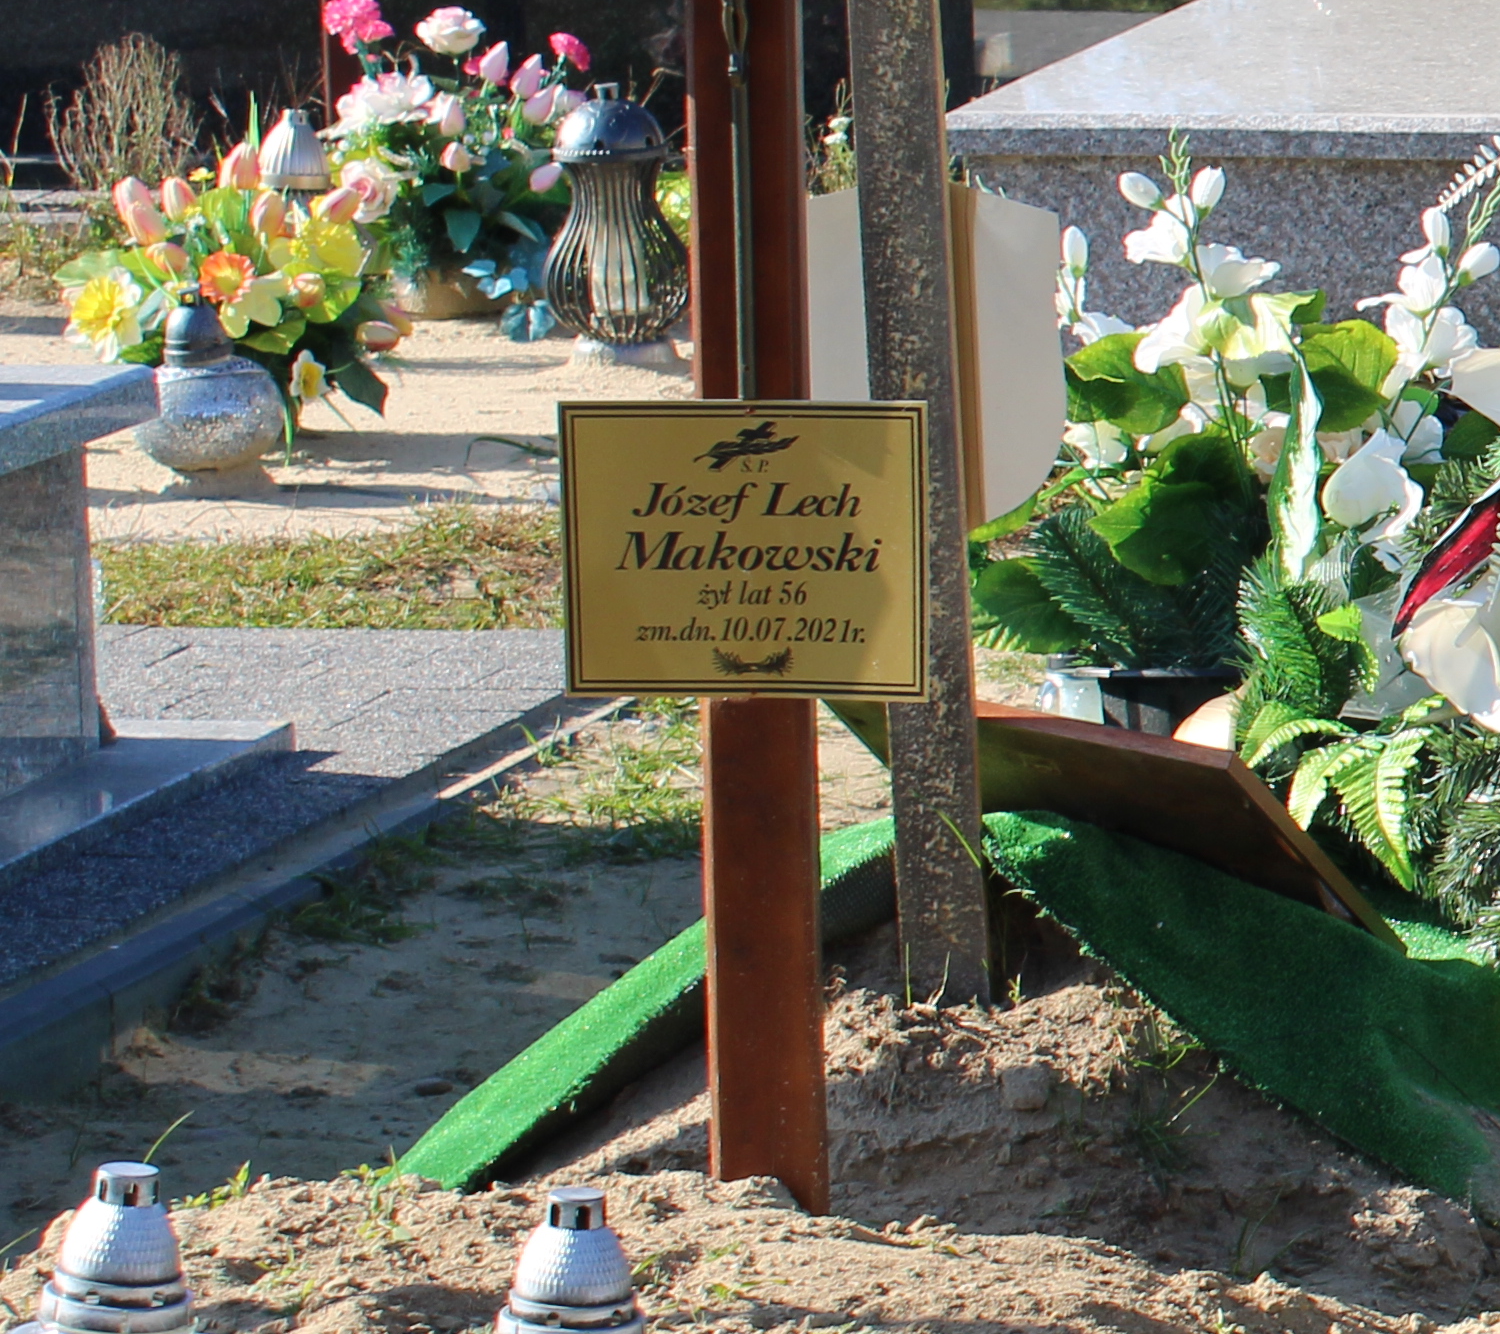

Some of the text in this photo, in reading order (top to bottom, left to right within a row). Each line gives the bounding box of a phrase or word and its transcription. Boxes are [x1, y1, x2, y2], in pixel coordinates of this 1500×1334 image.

[632, 482, 863, 524] Józef Lech
[615, 530, 883, 573] Makowski
[697, 580, 808, 610] żył lat 56
